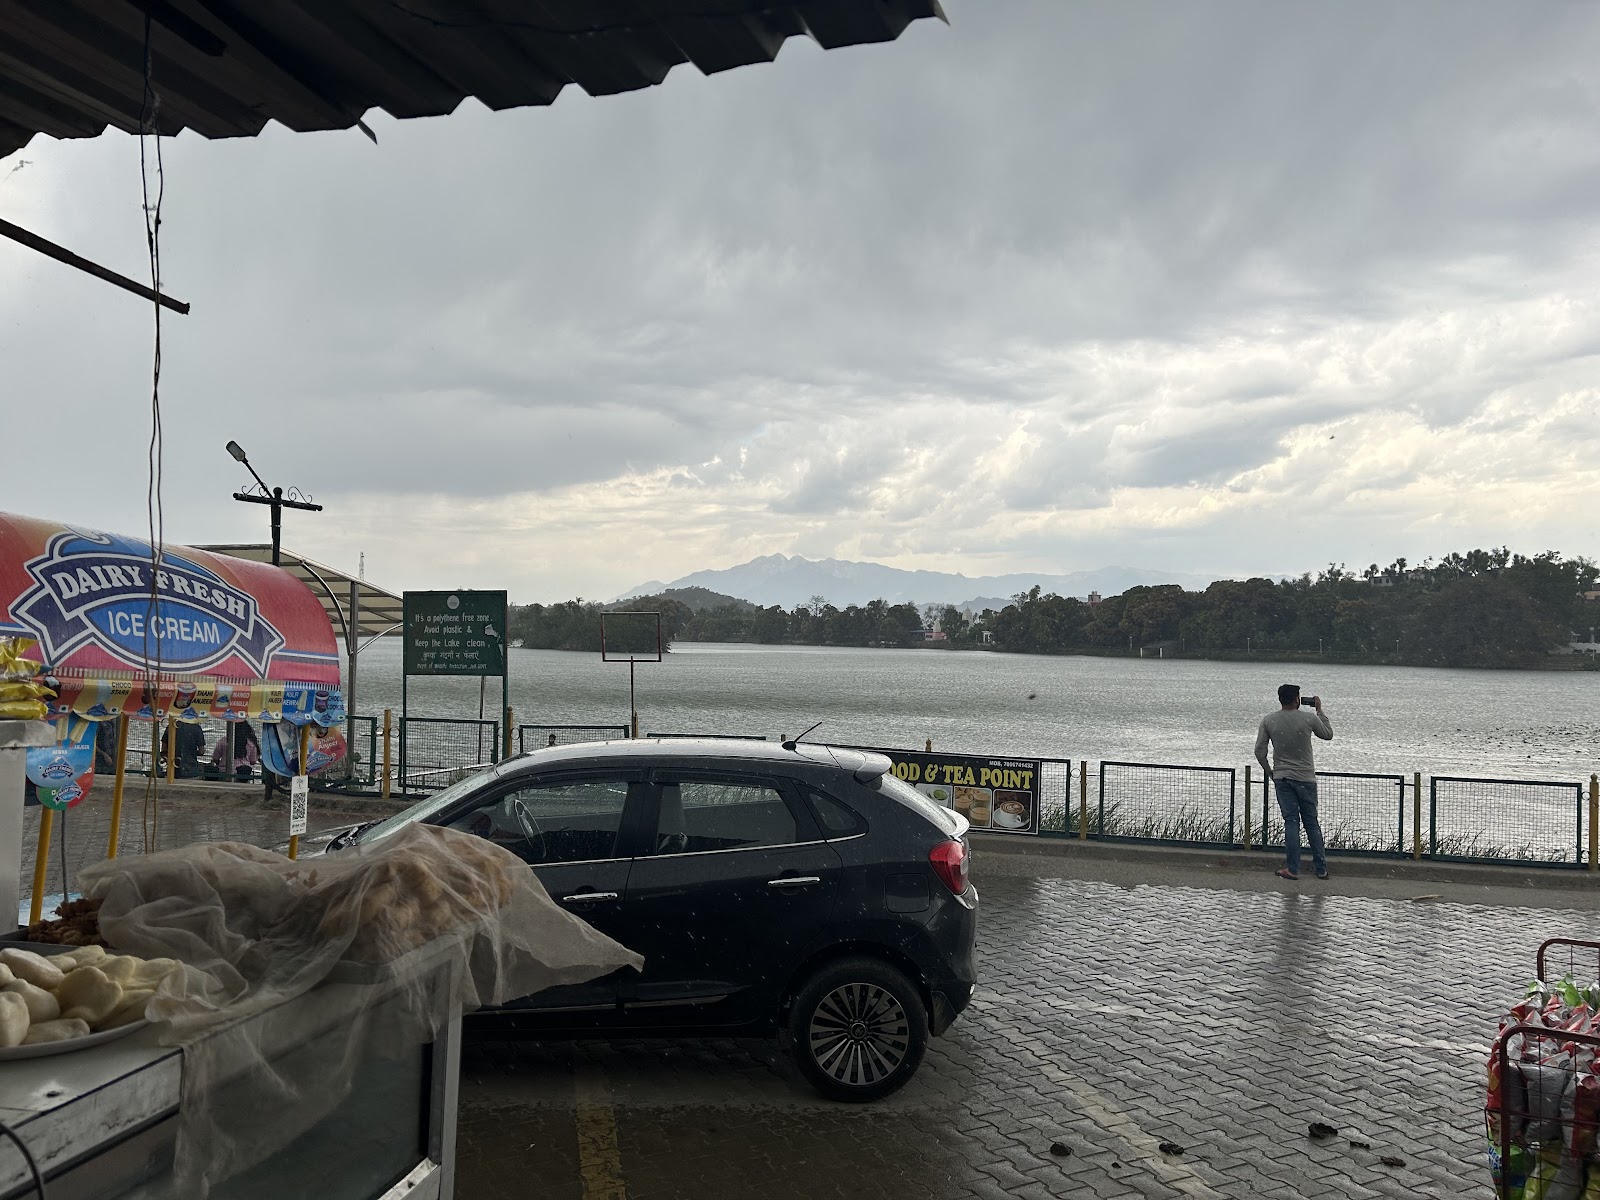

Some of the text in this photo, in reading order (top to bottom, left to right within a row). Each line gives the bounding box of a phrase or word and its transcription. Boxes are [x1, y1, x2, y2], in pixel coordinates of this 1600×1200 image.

[52, 565, 246, 620] DAIRY FRESH
[433, 613, 459, 624] polythene
[462, 613, 475, 622] free
[107, 611, 221, 645] ICE CREAM
[424, 625, 472, 635] Avoid plastic &
[415, 639, 428, 648] Keep
[431, 639, 441, 647] the
[444, 639, 460, 647] Lake
[925, 764, 938, 782] &
[943, 766, 976, 786] TEA
[980, 767, 1034, 789] POINT
